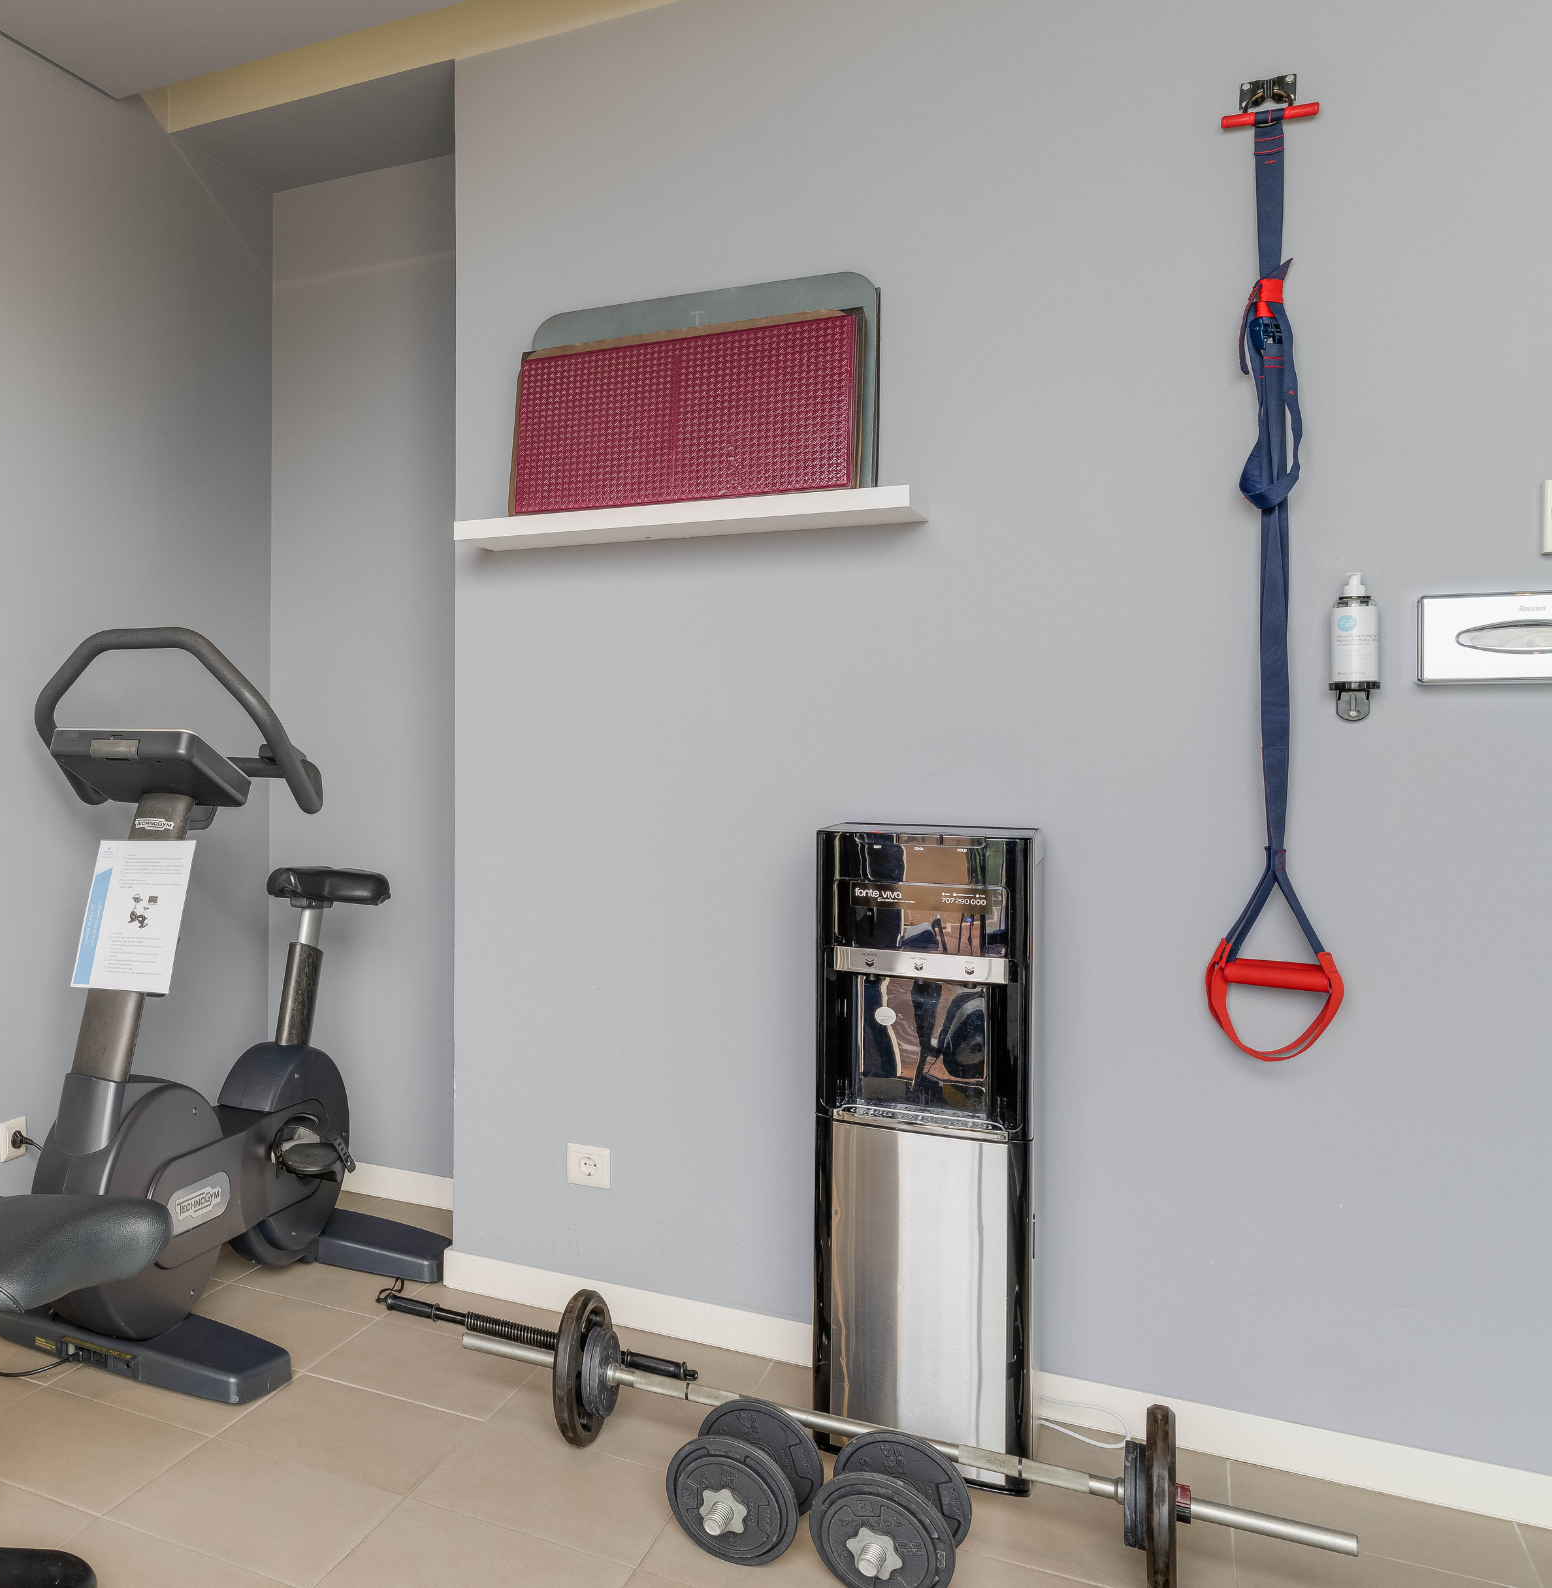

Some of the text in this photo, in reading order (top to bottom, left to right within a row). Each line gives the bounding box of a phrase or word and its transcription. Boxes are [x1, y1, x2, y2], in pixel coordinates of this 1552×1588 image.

[855, 887, 903, 899] fonte viva
[177, 1189, 220, 1216] TECHNOGYM
